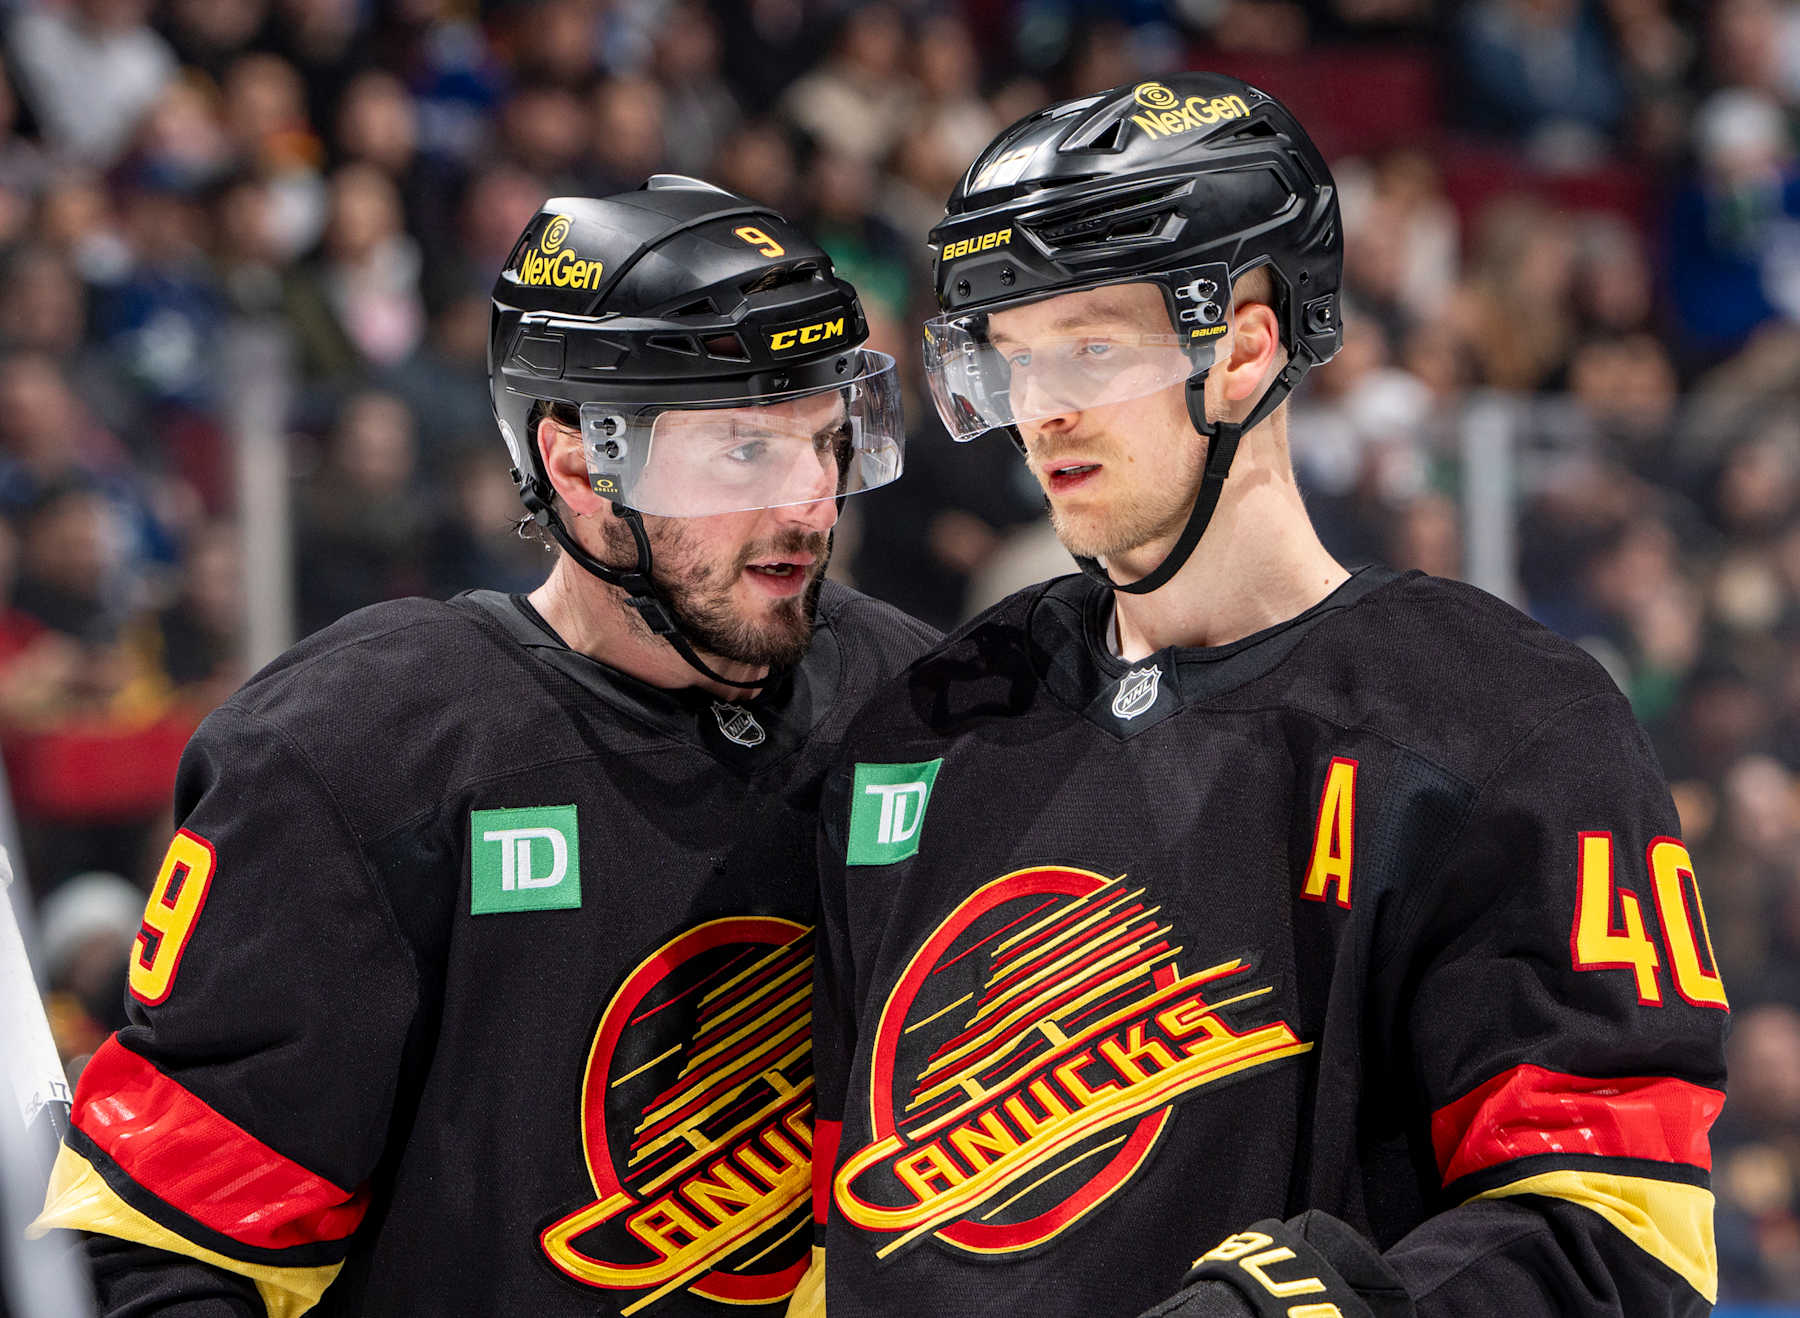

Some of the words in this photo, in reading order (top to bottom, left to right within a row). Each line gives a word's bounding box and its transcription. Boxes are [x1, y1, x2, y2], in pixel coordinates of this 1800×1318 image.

[1132, 93, 1251, 140] NexGen
[518, 247, 603, 291] NexGen
[735, 226, 785, 258] 9
[770, 317, 844, 351] CCM
[1122, 680, 1151, 709] NHL
[864, 780, 927, 844] TD
[1300, 755, 1359, 910] A
[483, 826, 569, 891] TD
[129, 827, 217, 1007] 9
[1570, 830, 1730, 1014] 40
